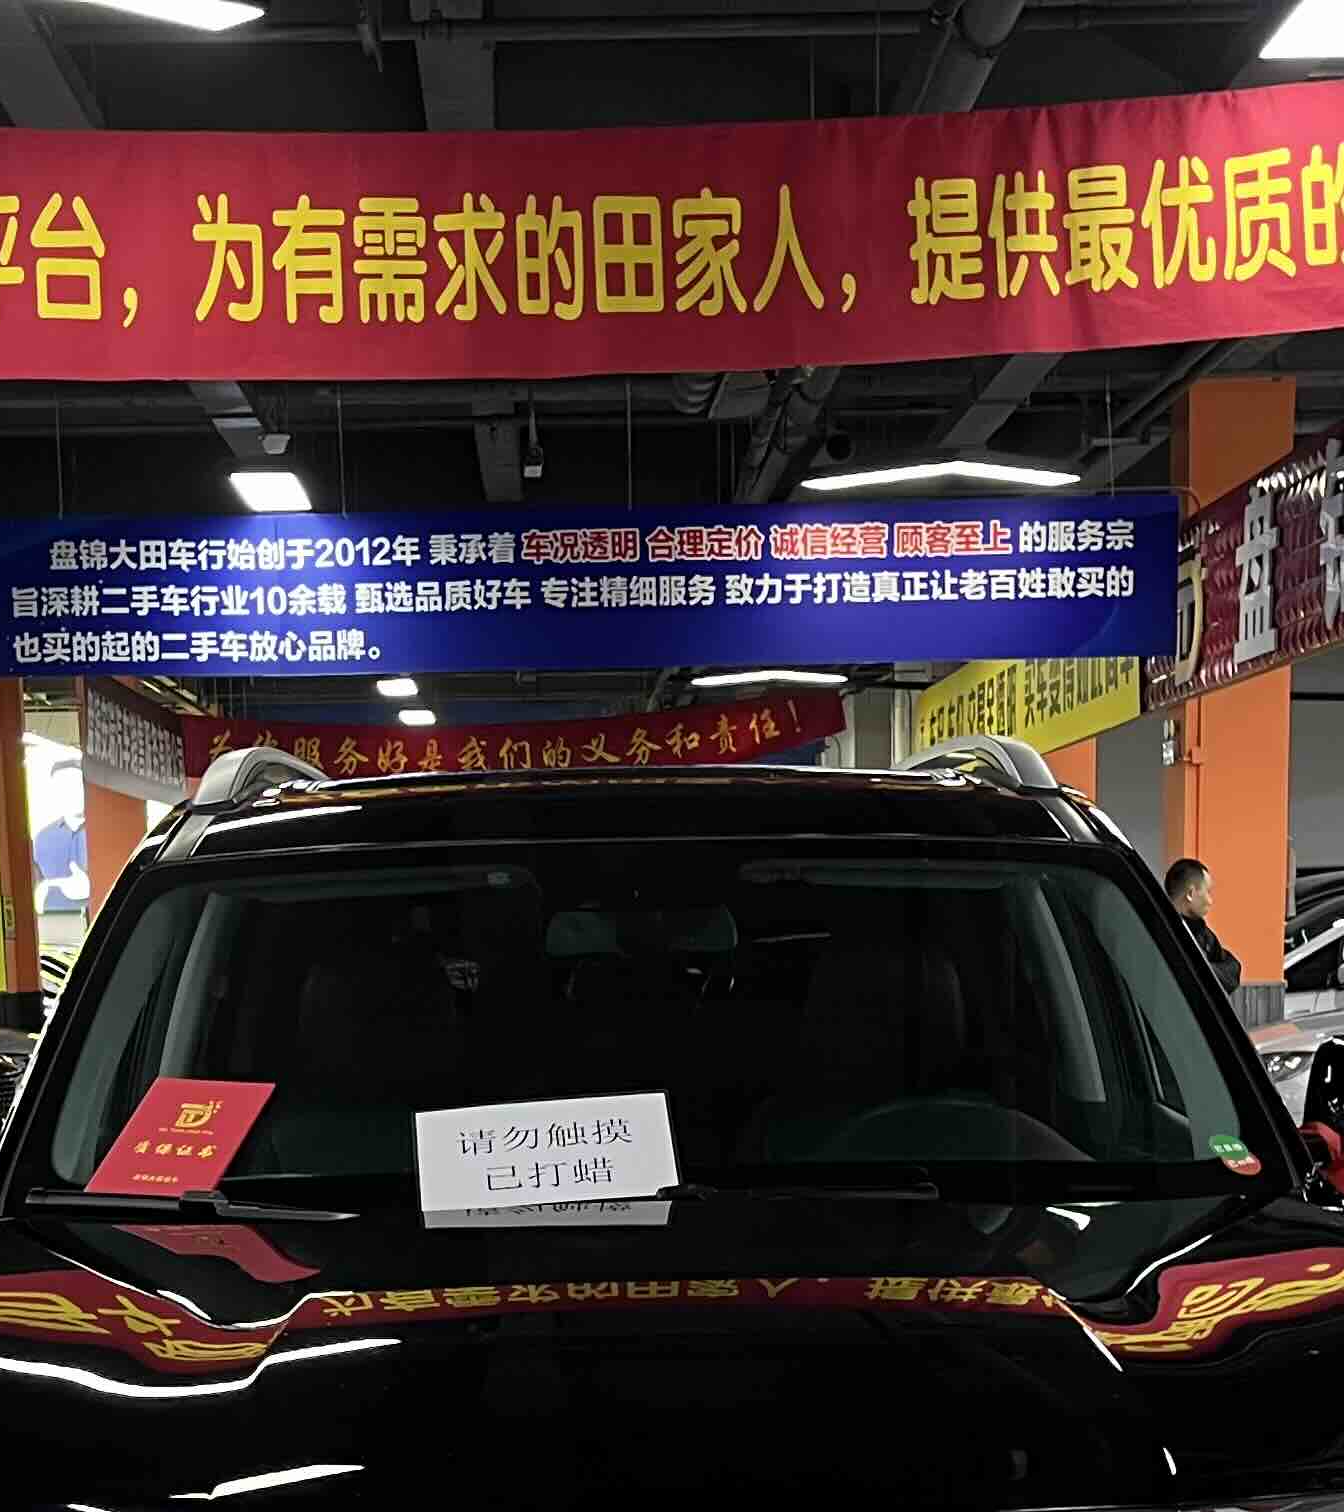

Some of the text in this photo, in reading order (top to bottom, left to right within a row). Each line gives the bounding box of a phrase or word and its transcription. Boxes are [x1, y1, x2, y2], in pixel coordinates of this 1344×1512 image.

[49, 518, 1134, 572] 盘锦大田车行始创于2012年 秉承着 车况透明 合理定价 诚信经营 顾客至上 的服务宗
[11, 565, 1134, 619] 旨深耕二手车行业10余载 甄选品质好车 专注精细服务 致力于打造真正让老百姓敢买的
[13, 628, 381, 664] 也买的起的二手车放心品牌。
[457, 1117, 633, 1156] 请勿触摸
[485, 1157, 616, 1190] 已打蜡
